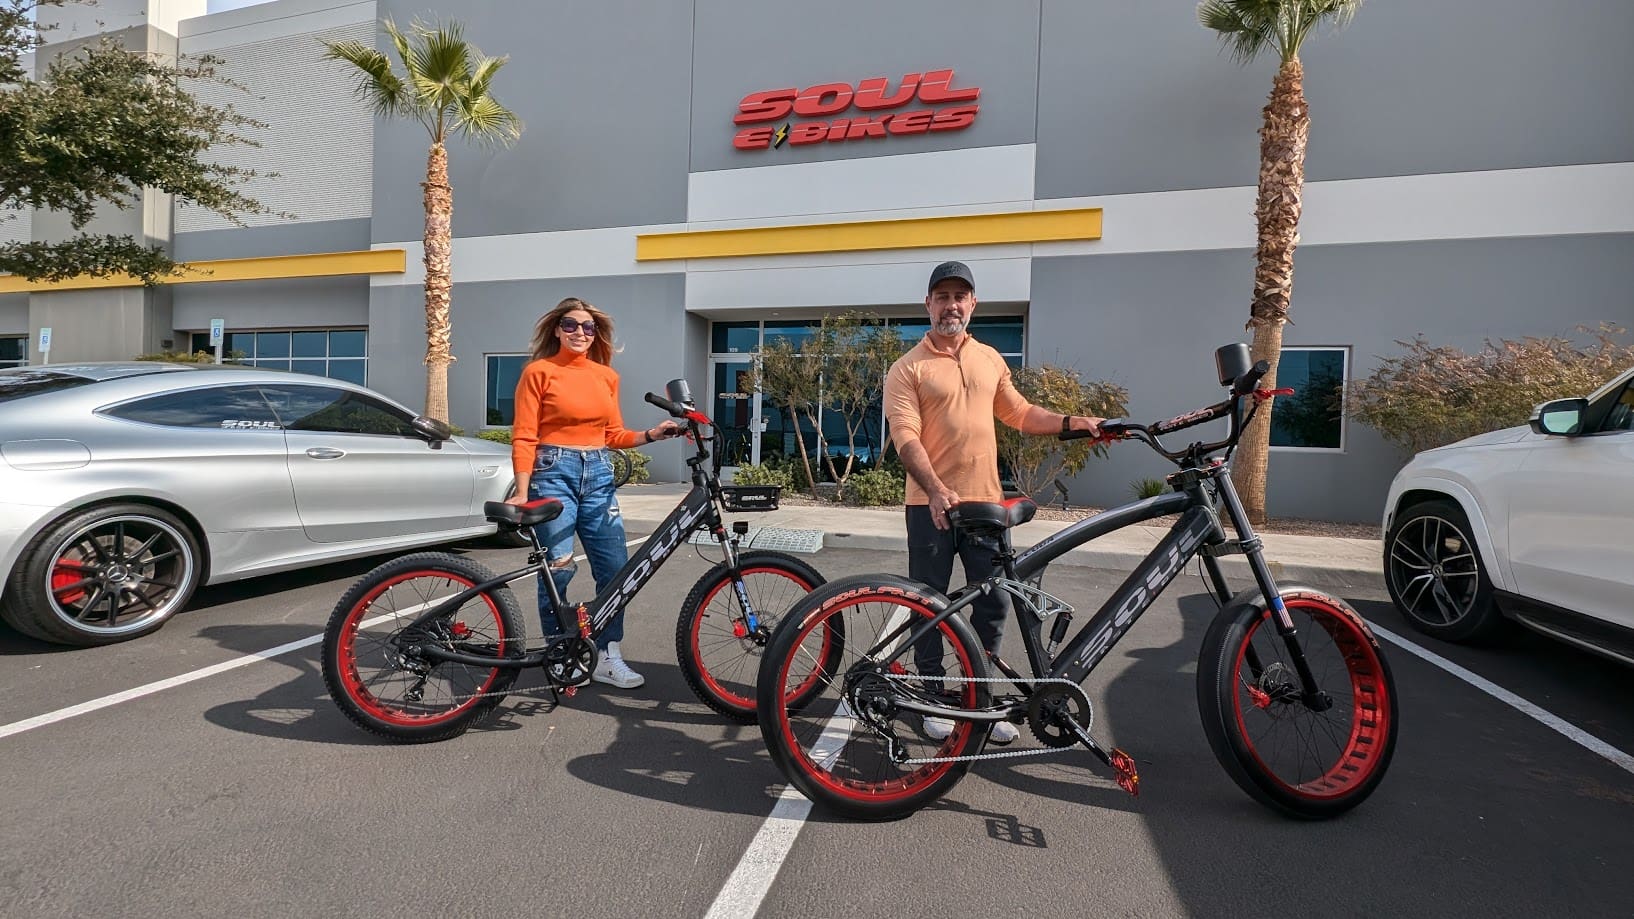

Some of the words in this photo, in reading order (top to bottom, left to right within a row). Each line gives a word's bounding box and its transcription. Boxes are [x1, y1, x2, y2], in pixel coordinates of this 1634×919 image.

[733, 69, 981, 125] SOUL
[221, 419, 281, 429] SOUL
[593, 501, 708, 630] SOUL
[822, 586, 876, 611] SOUL
[1080, 520, 1213, 669] SOUL
